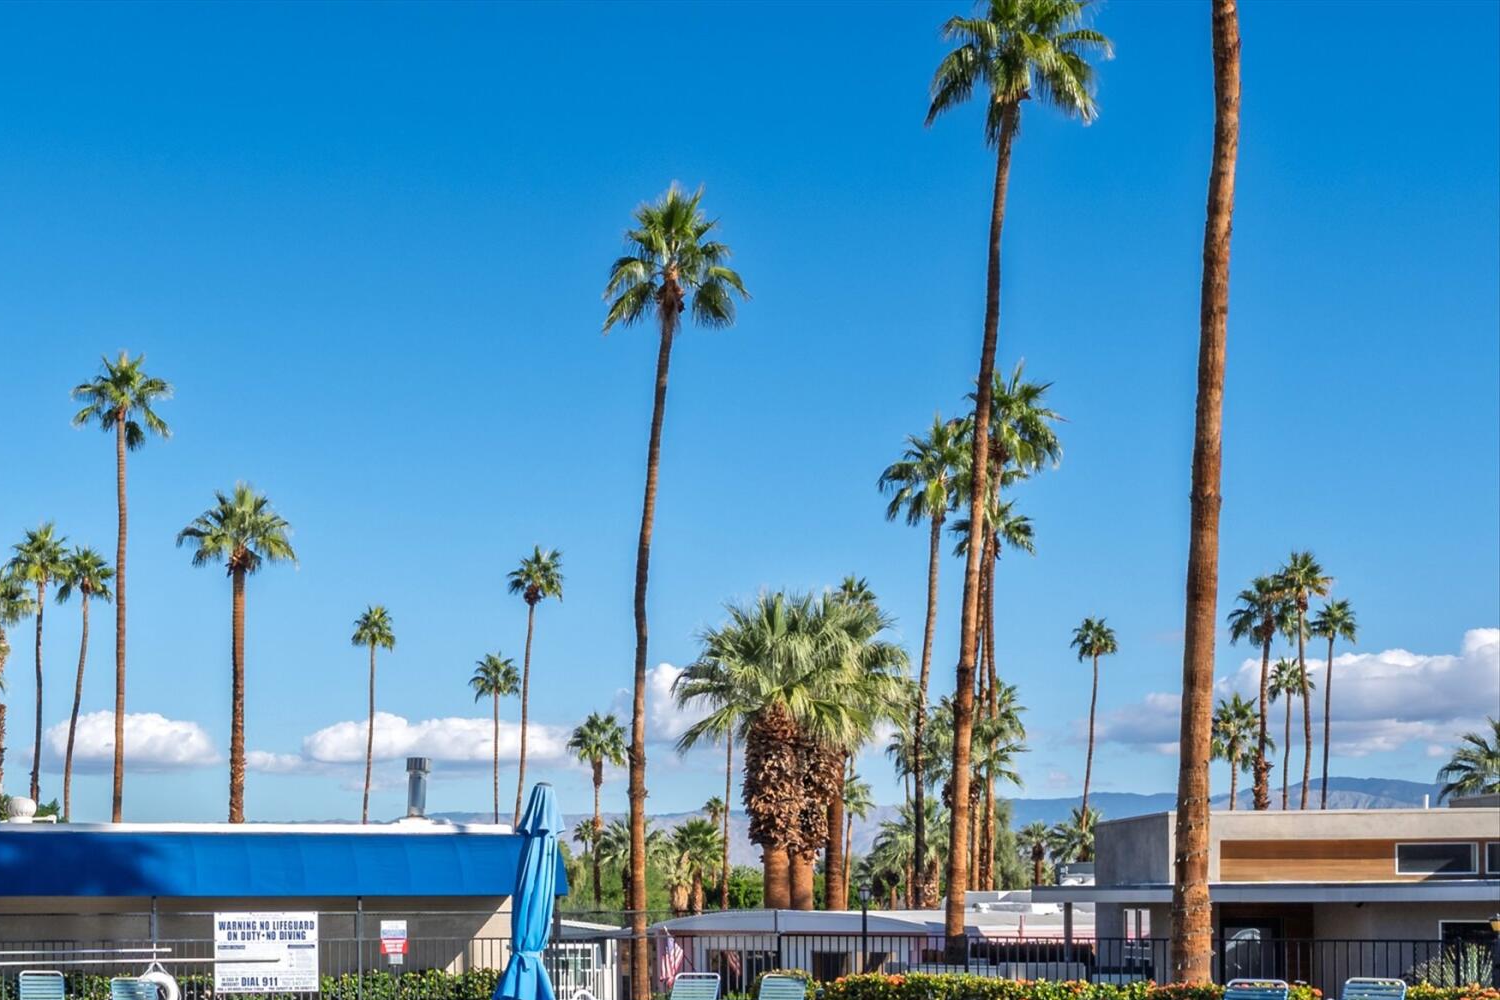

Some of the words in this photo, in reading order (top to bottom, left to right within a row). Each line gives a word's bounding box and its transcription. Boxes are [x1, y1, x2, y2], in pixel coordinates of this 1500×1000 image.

[218, 920, 257, 931] WARNING
[259, 920, 270, 931] NO
[272, 920, 315, 931] LIFEGUARD
[227, 931, 238, 941] ON
[240, 931, 261, 941] DUTY
[266, 931, 277, 941] NO
[279, 931, 307, 941] DIVING
[241, 976, 260, 987] DIAL
[262, 976, 278, 987] 911
